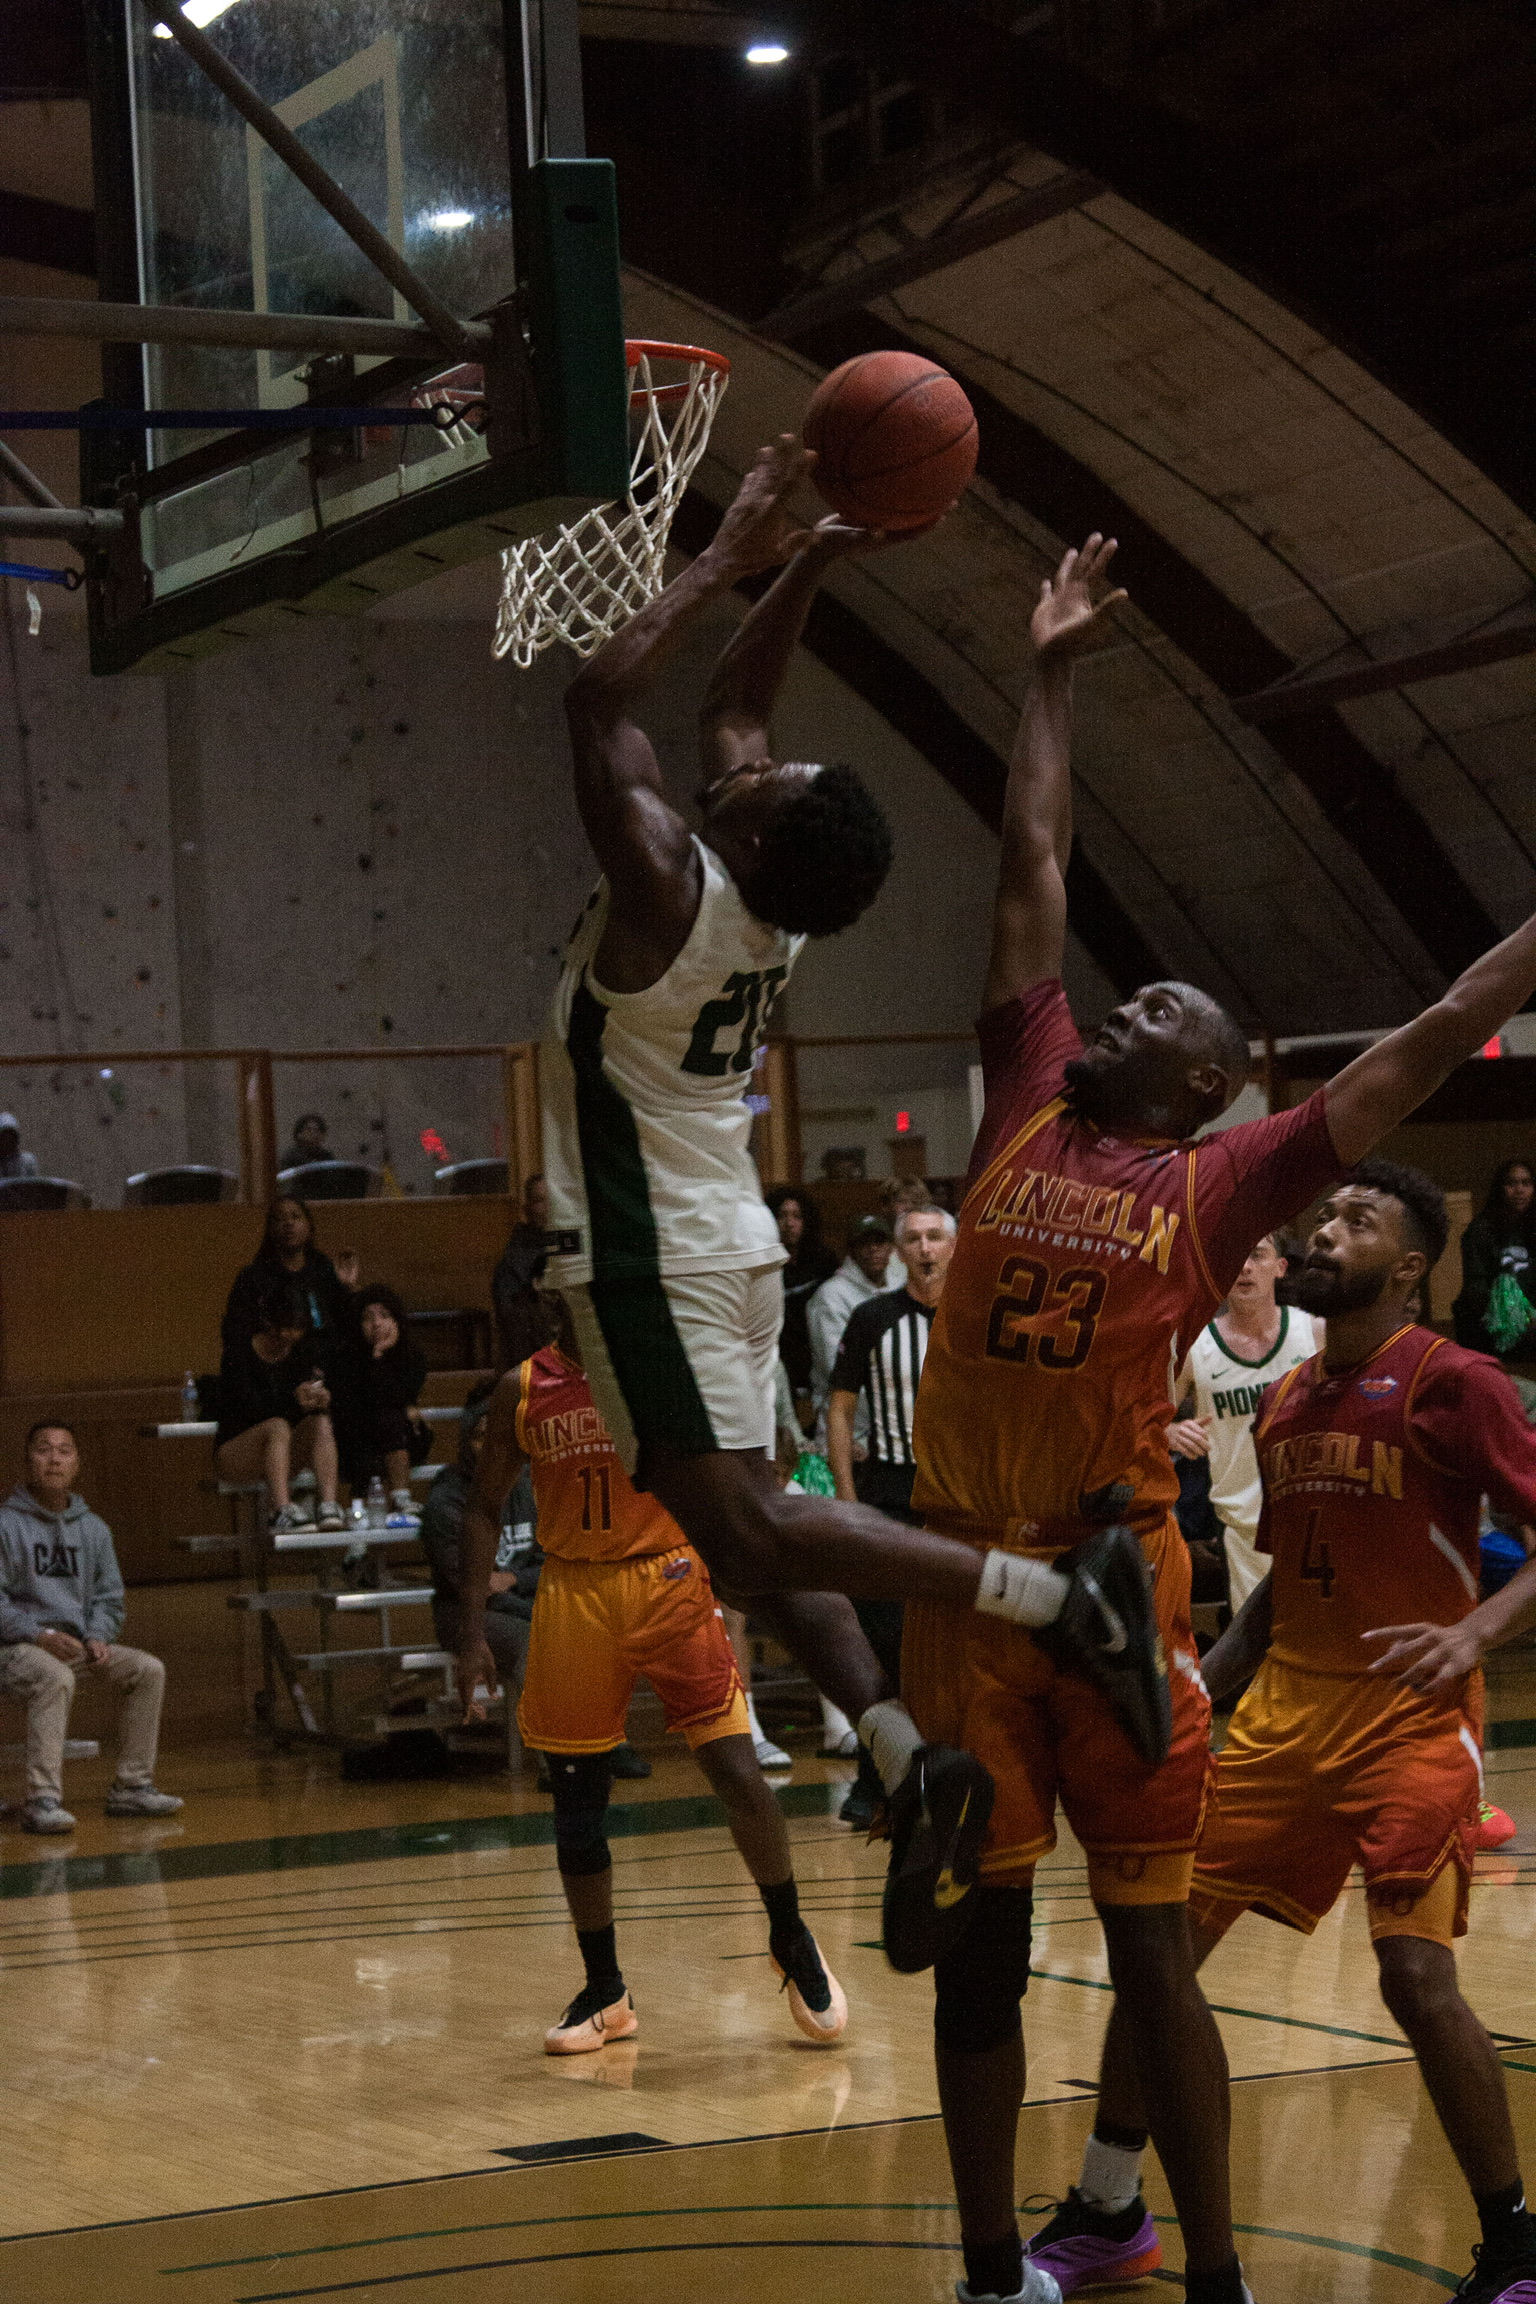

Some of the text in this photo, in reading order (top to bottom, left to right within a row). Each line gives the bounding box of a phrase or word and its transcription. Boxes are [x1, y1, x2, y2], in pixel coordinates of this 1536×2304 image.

[974, 1168, 1181, 1275] LINCOLN
[1000, 1222, 1132, 1261] UNIVERSITY
[985, 1253, 1109, 1374] 23
[1212, 1382, 1272, 1419] PION
[577, 1463, 613, 1531] 11
[34, 1543, 79, 1577] CAT
[1300, 1505, 1336, 1600] 4
